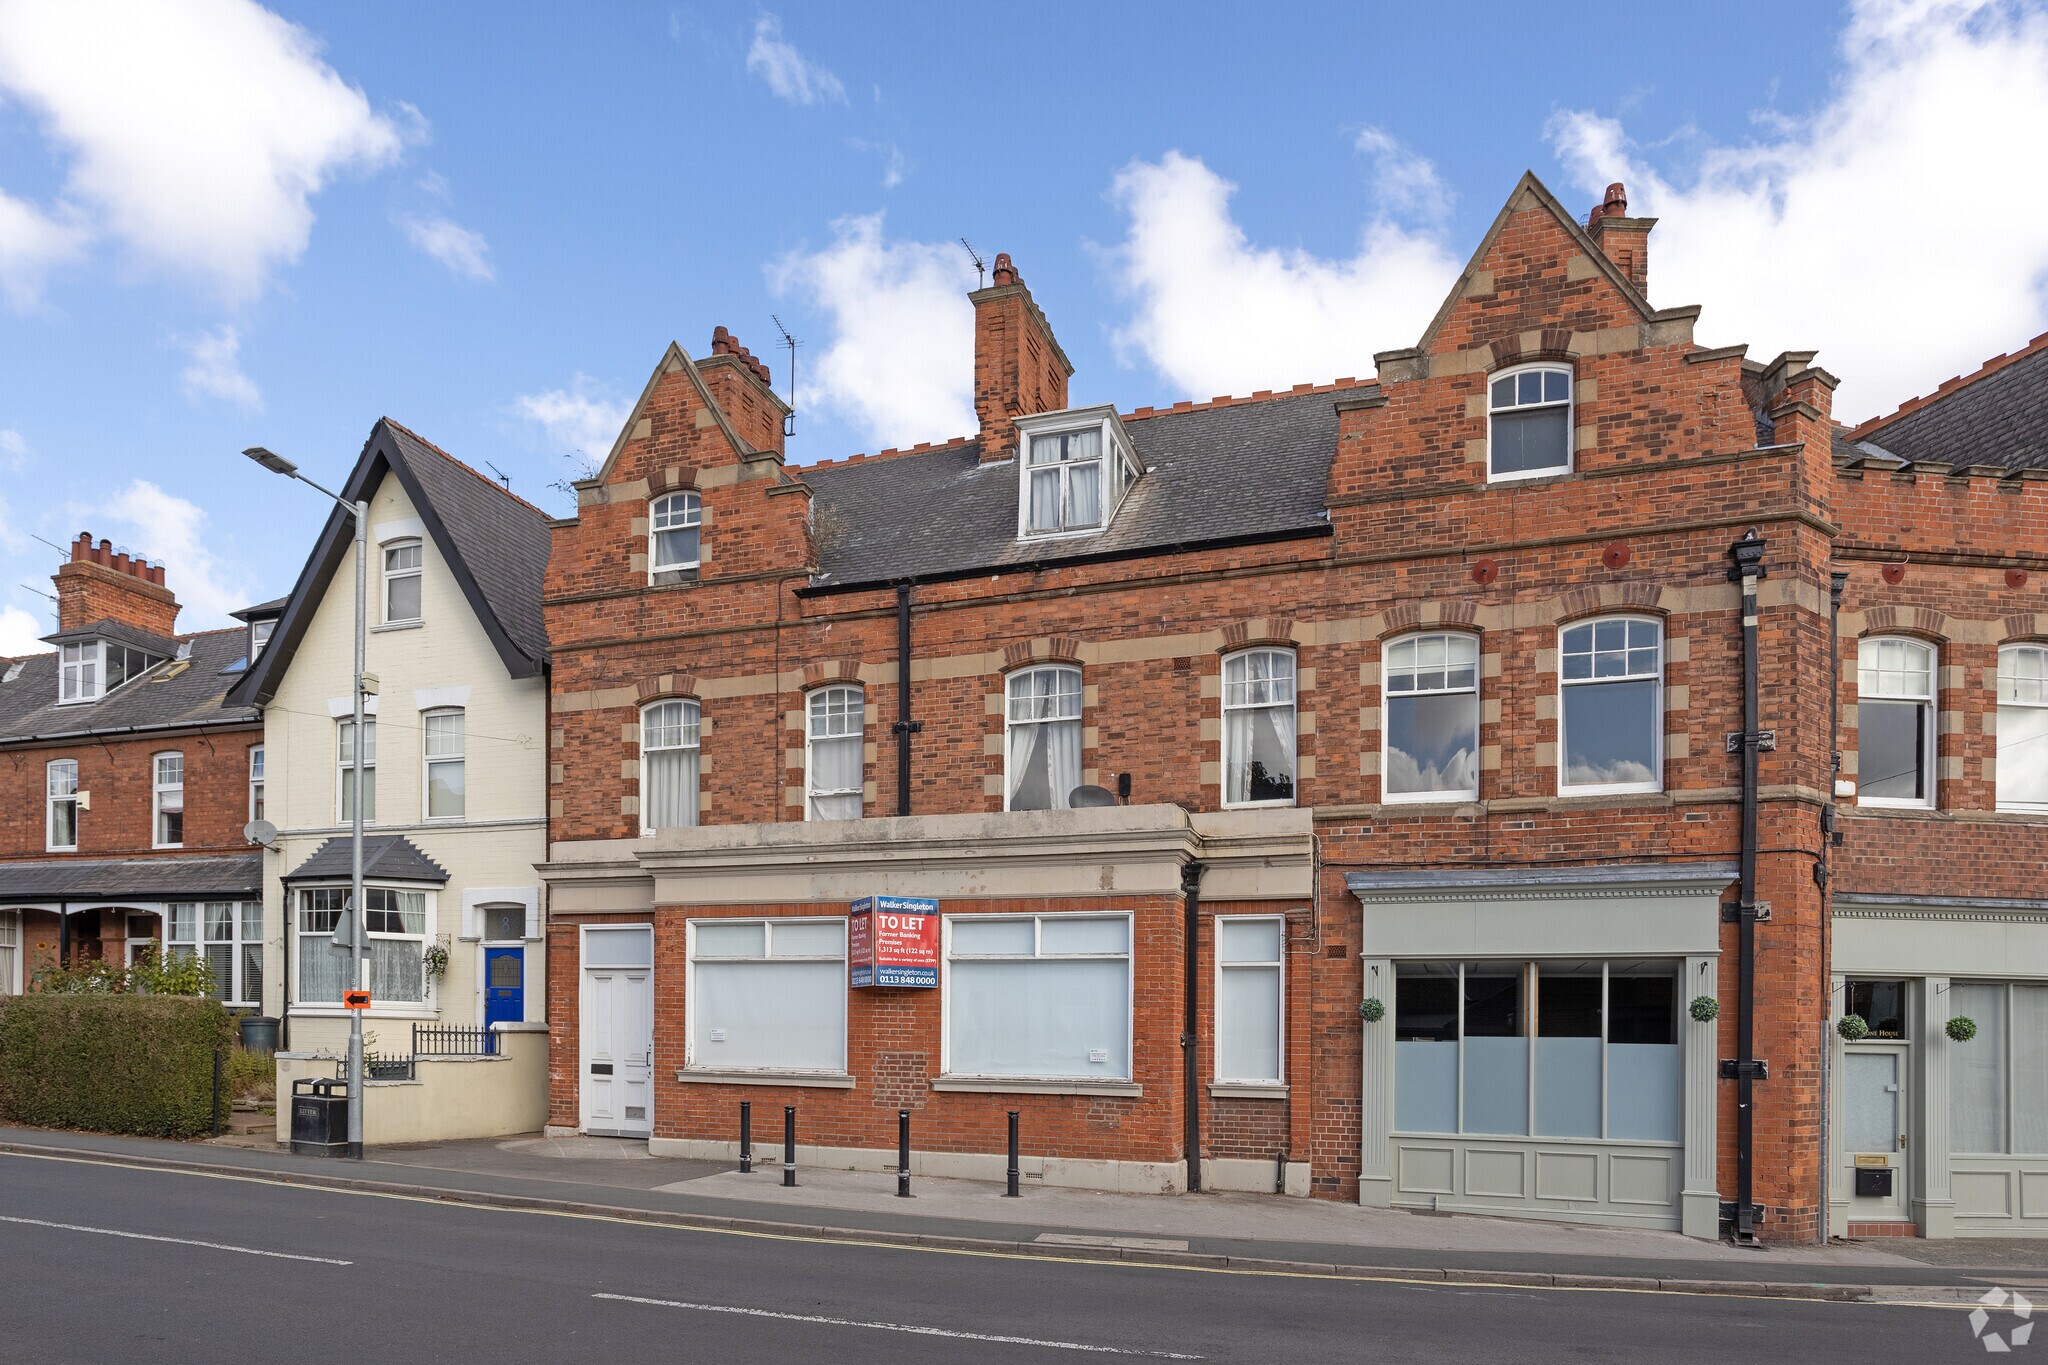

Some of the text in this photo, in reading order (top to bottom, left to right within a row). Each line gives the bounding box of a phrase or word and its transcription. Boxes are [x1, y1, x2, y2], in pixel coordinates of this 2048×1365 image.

[502, 916, 510, 932] 8
[852, 917, 867, 931] TO LET
[879, 916, 925, 930] TO LET
[900, 932, 920, 940] Banking
[880, 968, 935, 977] walkersingleton.co.uk
[880, 975, 936, 985] 0113 848 0000
